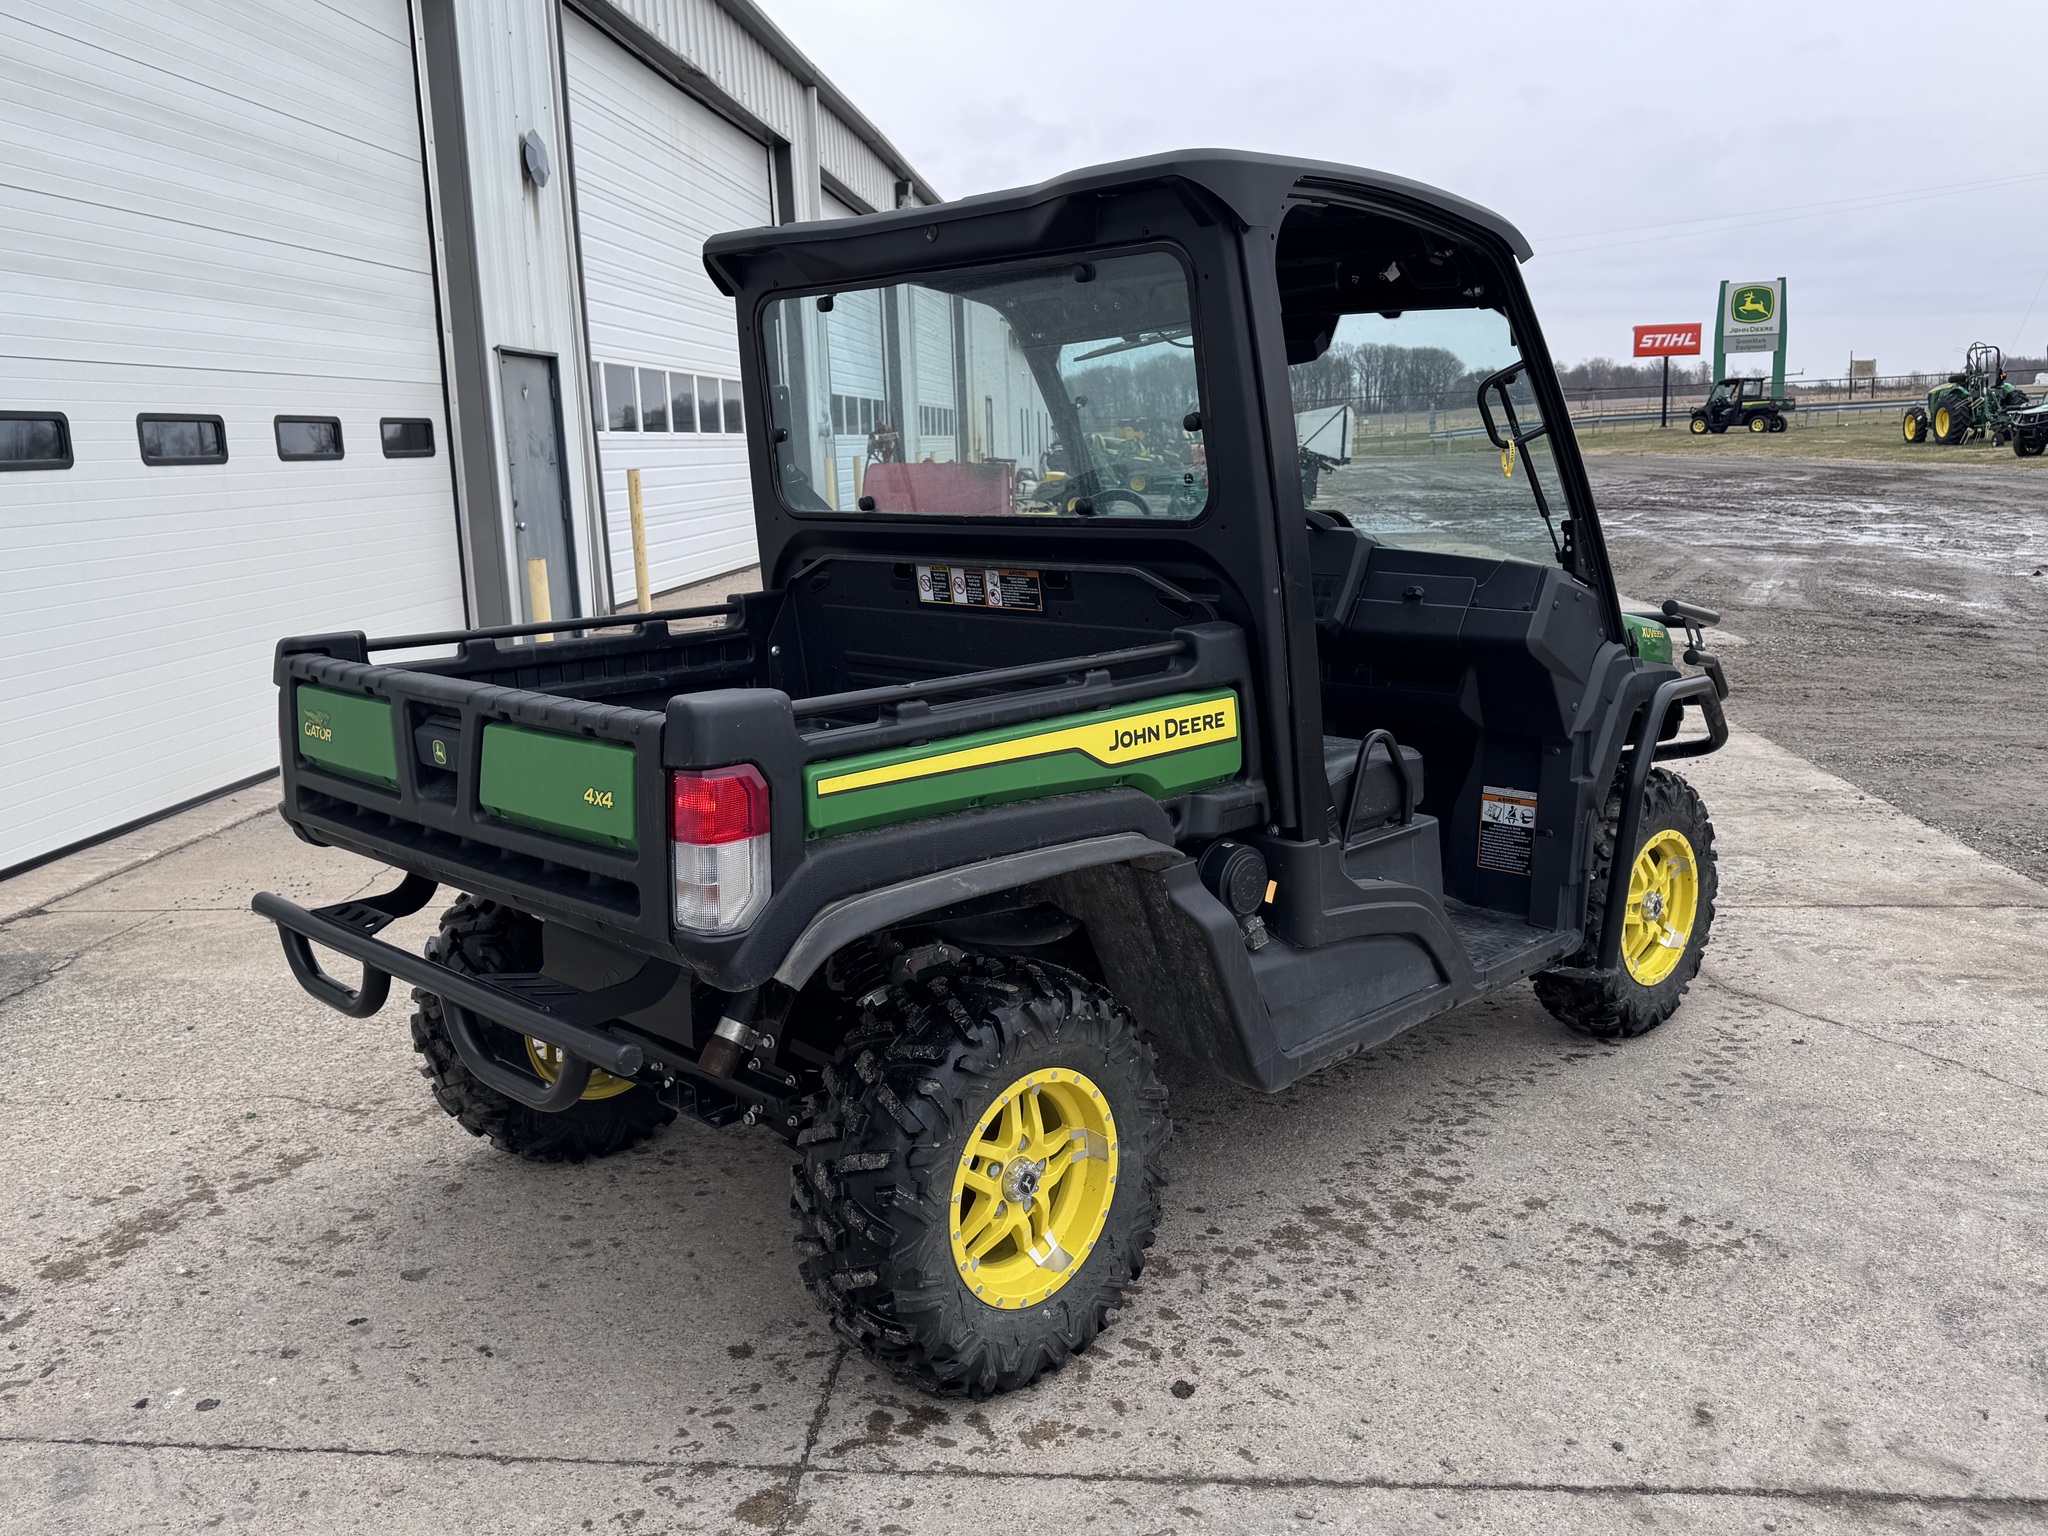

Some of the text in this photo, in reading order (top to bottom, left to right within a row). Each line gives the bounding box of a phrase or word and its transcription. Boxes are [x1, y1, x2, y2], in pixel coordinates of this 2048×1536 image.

[1639, 333, 1696, 348] STIHL
[1735, 337, 1767, 345] GreenMark
[304, 721, 332, 742] GATOR
[1109, 711, 1225, 751] JOHN DEERE
